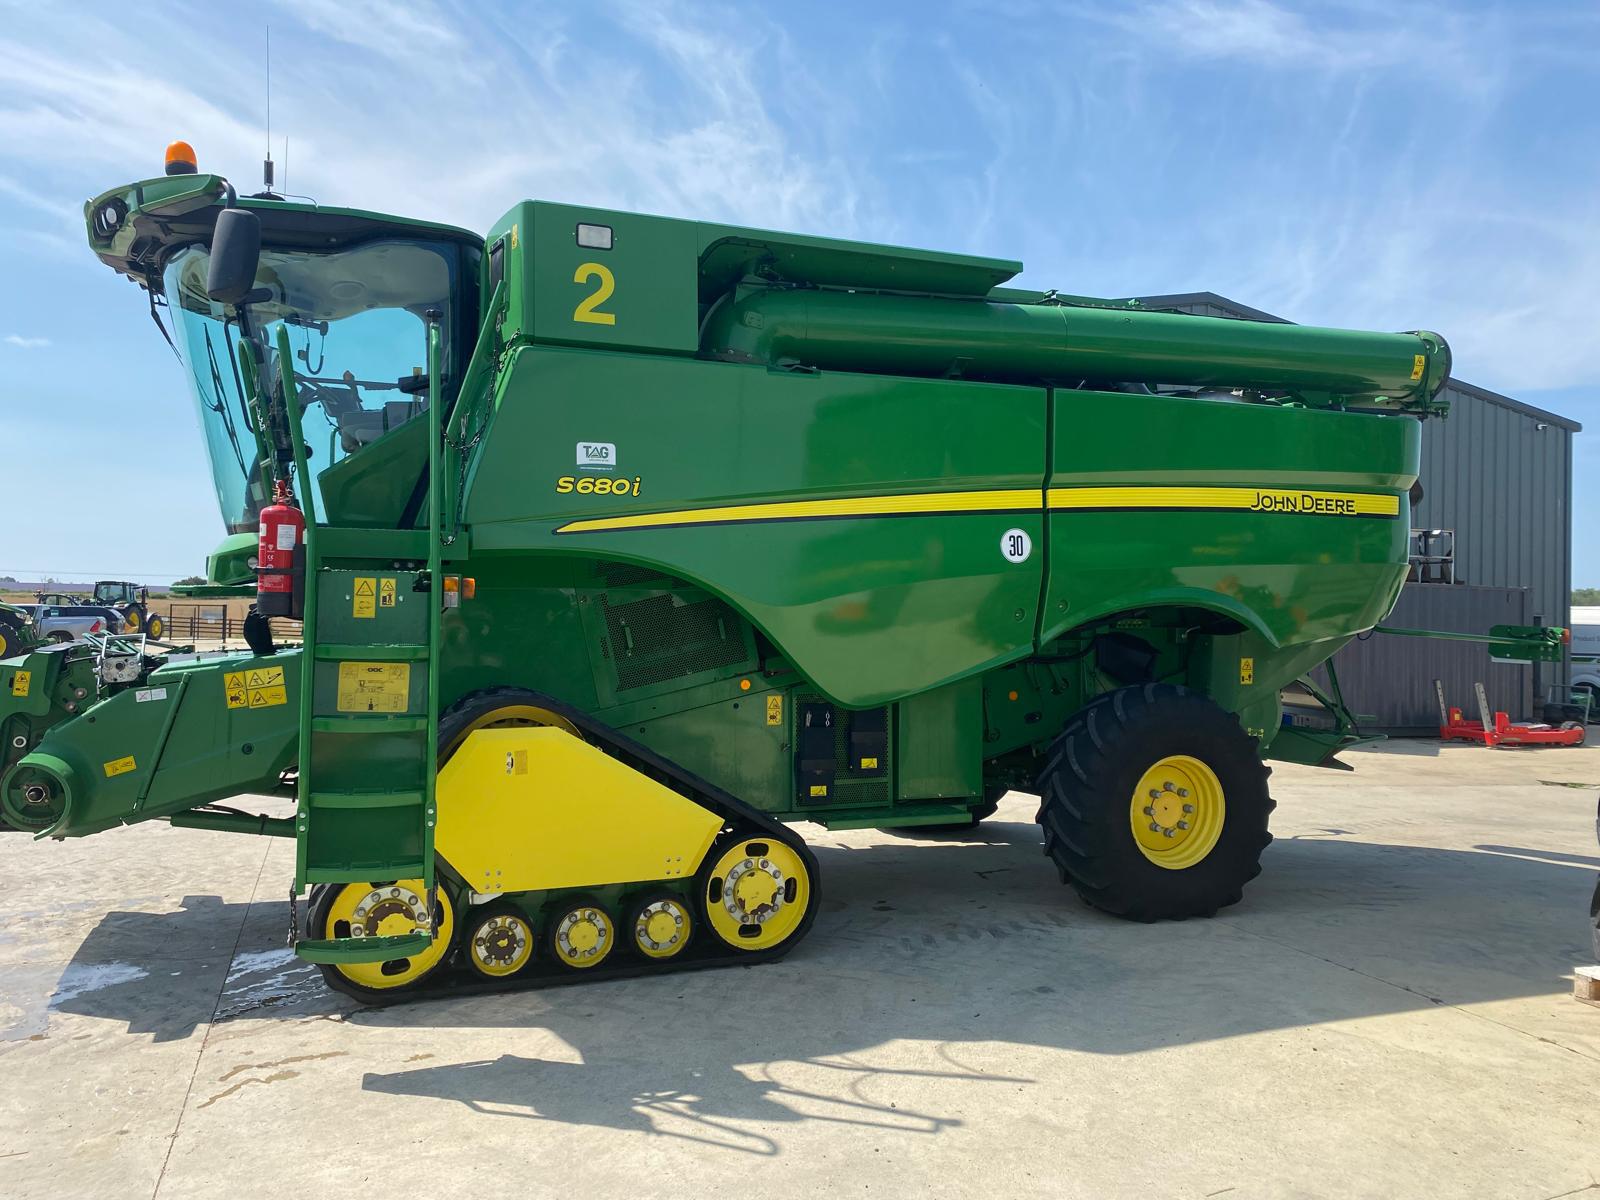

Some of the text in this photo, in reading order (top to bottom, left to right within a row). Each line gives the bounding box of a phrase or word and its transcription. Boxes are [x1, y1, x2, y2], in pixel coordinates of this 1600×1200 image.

[573, 262, 616, 326] 2
[583, 446, 609, 459] TAG
[556, 475, 641, 497] S680i
[1251, 491, 1356, 514] JOHN DEERE
[1009, 535, 1024, 556] 30
